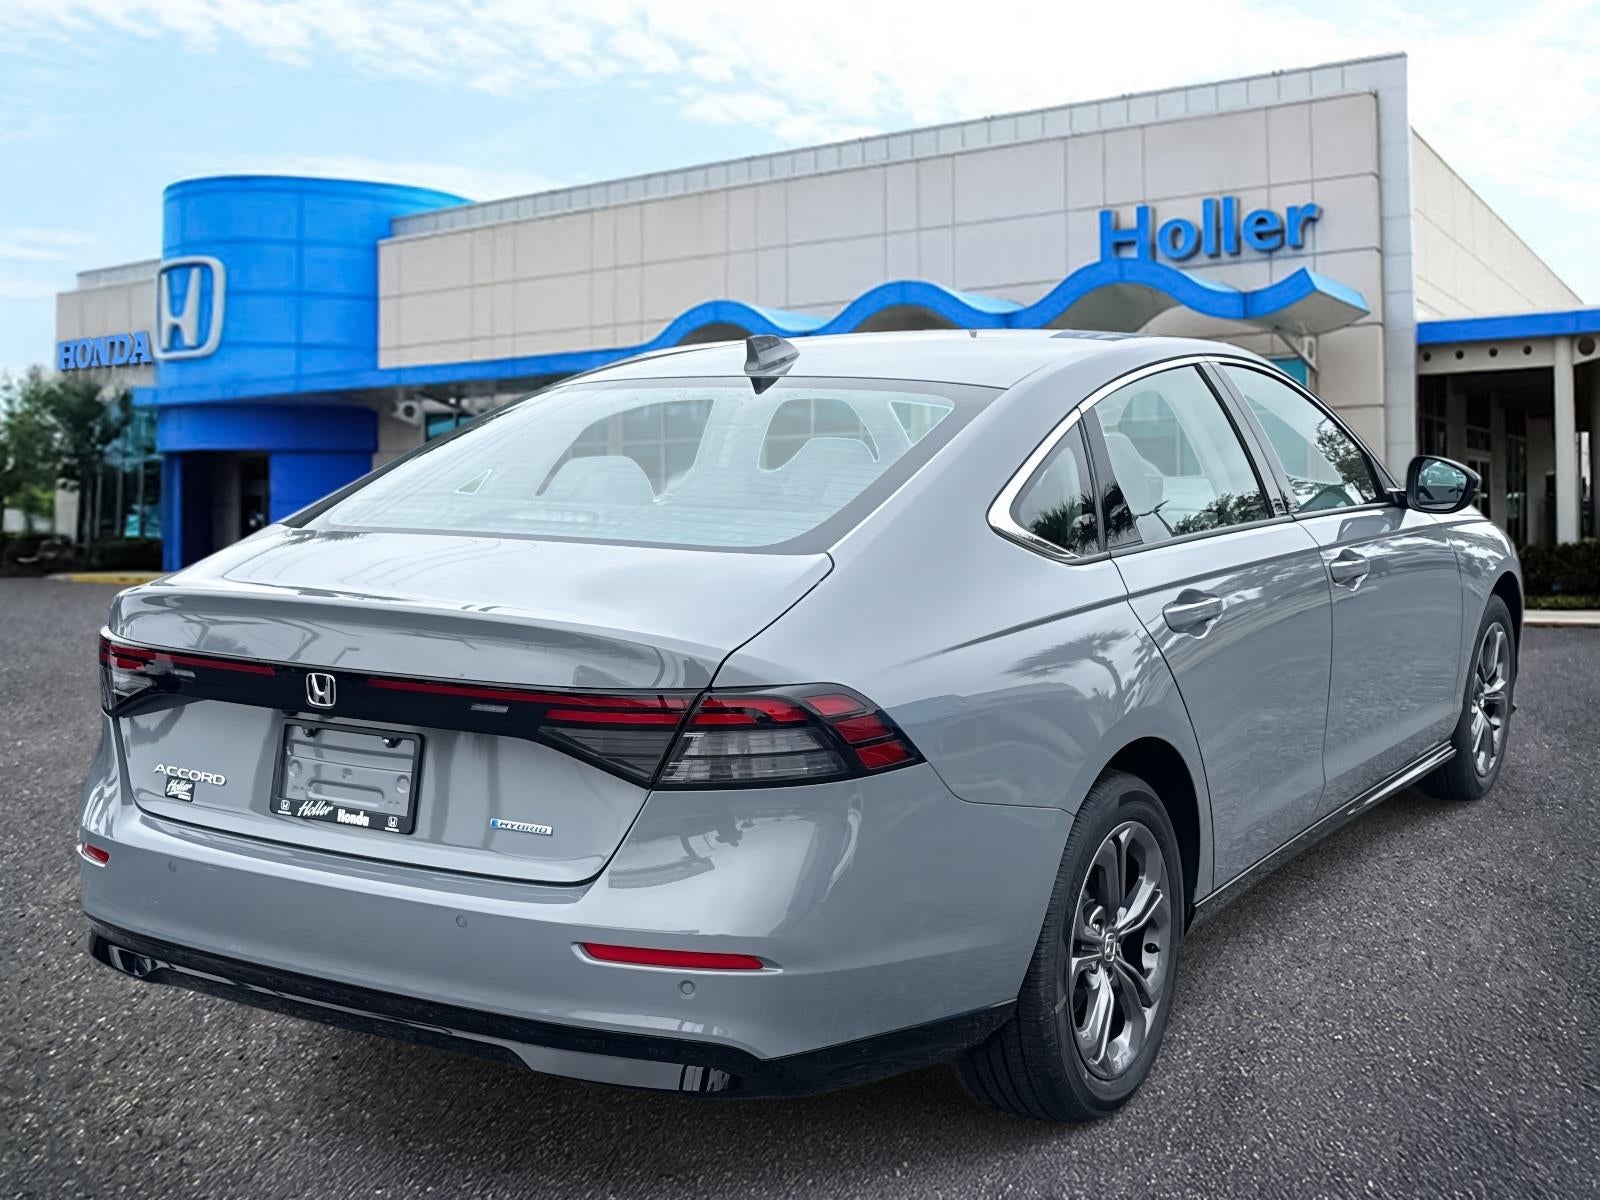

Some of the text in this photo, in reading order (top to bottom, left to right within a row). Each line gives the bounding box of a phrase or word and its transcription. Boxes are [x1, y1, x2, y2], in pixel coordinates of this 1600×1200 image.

[1099, 196, 1321, 262] Holler
[58, 331, 152, 370] HONDA
[154, 763, 227, 786] ACCORD
[297, 800, 370, 827] Holler Honda
[499, 821, 549, 834] HYBRID
